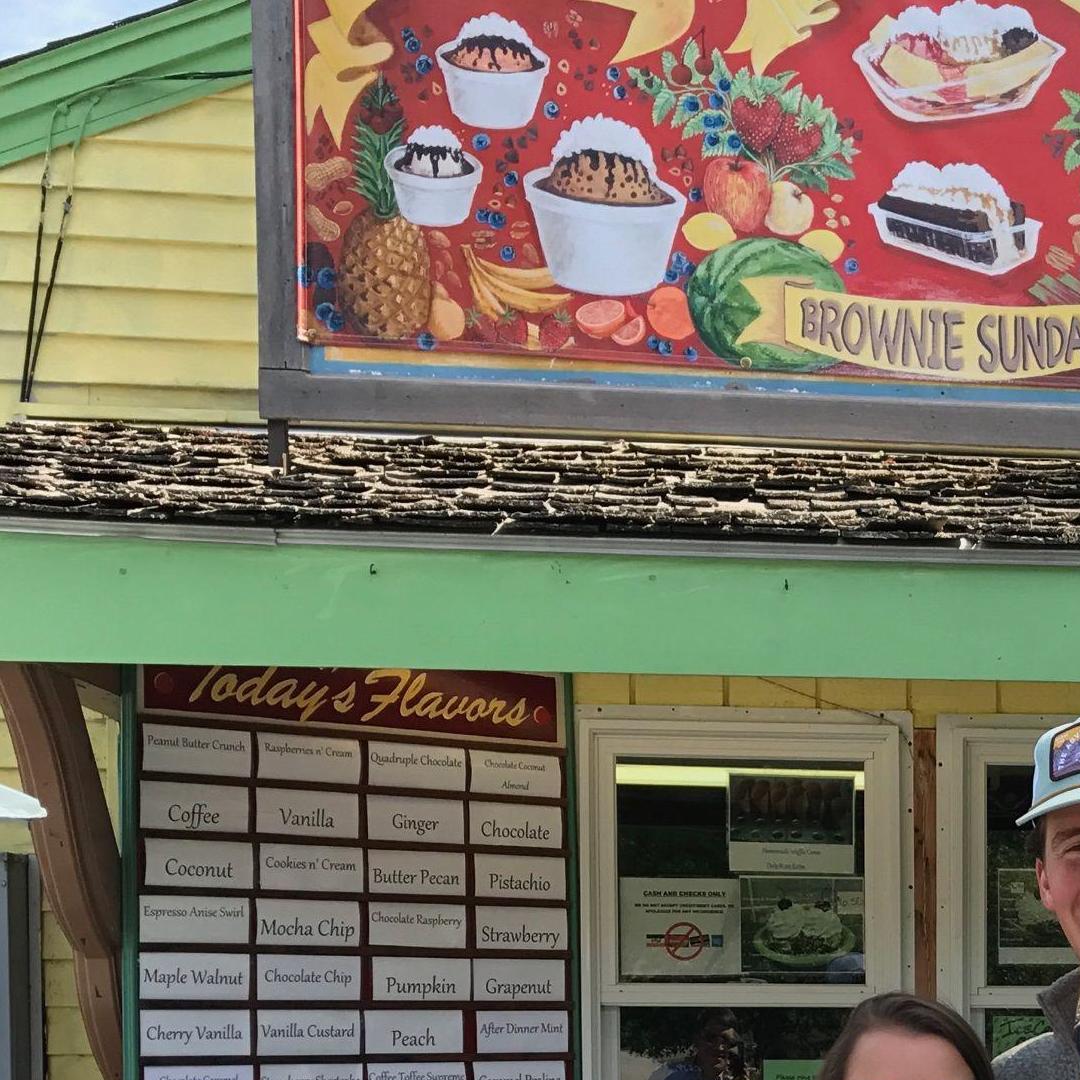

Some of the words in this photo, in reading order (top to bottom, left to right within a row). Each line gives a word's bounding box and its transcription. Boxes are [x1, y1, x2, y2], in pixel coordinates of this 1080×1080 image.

[801, 298, 967, 371] BROWNIE
[361, 668, 530, 727] Flavors
[148, 735, 179, 747] Peanut
[181, 737, 211, 750] Butter
[212, 740, 245, 752] Crunch
[264, 742, 314, 756] Raspberries
[325, 747, 353, 758] Cream
[370, 752, 418, 766] Quadruple
[420, 755, 463, 768] Chocolate
[484, 759, 517, 770] Chocolate
[518, 762, 546, 772] Coconut
[501, 781, 530, 791] Almond
[168, 803, 220, 829] Coffee
[279, 808, 335, 828] Vanilla
[392, 813, 439, 836] Ginger
[481, 821, 550, 840] Chocolate
[165, 858, 234, 878] Coconut
[265, 856, 307, 870] Cookies
[321, 859, 356, 871] Cream
[373, 868, 417, 885] Butter
[420, 869, 460, 885] Pecan
[489, 873, 551, 891] Pistachio
[143, 905, 187, 920] Espresso
[189, 906, 217, 918] Anise
[219, 905, 244, 918] Swirl
[371, 911, 415, 925] Chocolate
[416, 914, 462, 929] Raspberry
[260, 917, 313, 936] Mocha
[318, 918, 355, 942] Chip
[481, 924, 560, 949] Strawberry
[143, 968, 187, 988] Maple
[191, 968, 243, 985] Walnut
[264, 968, 321, 983] Chocolate
[324, 969, 352, 988] Chip
[385, 975, 456, 1000] Pumpkin
[485, 978, 552, 999] Grapenut
[146, 1024, 193, 1045] Cherry
[195, 1023, 243, 1041] Vanilla
[260, 1023, 303, 1038] Vanilla
[307, 1022, 355, 1039] Custard
[391, 1027, 436, 1047] Peach
[480, 1022, 505, 1040] After
[505, 1022, 540, 1034] Dinner
[540, 1022, 563, 1034] Mint
